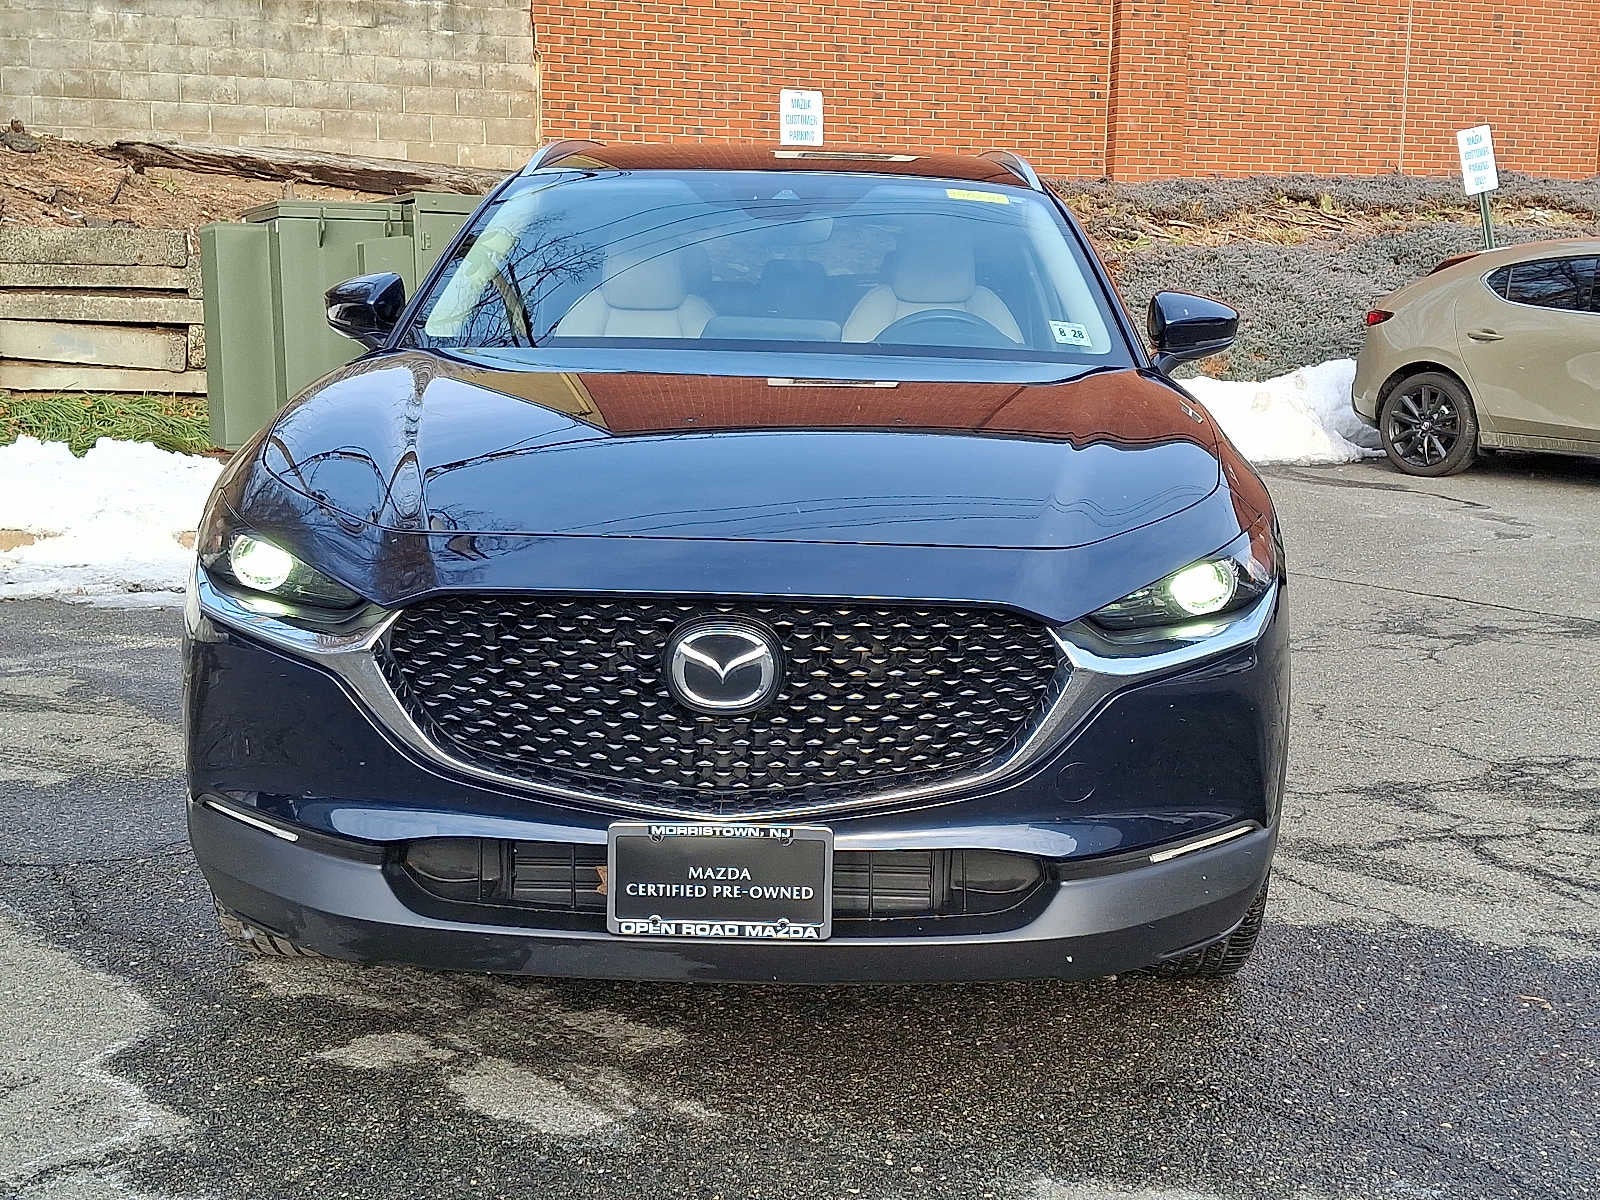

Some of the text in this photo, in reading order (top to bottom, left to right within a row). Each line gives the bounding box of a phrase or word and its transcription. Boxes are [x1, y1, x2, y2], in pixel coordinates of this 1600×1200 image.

[1058, 327, 1085, 339] 8 28
[650, 825, 792, 838] MORRISTOWN, NJ
[687, 866, 752, 881] MAZDA
[625, 883, 815, 900] CERTIFIED PRE-OWNED
[620, 921, 820, 939] OPEN ROAD MAZDA
